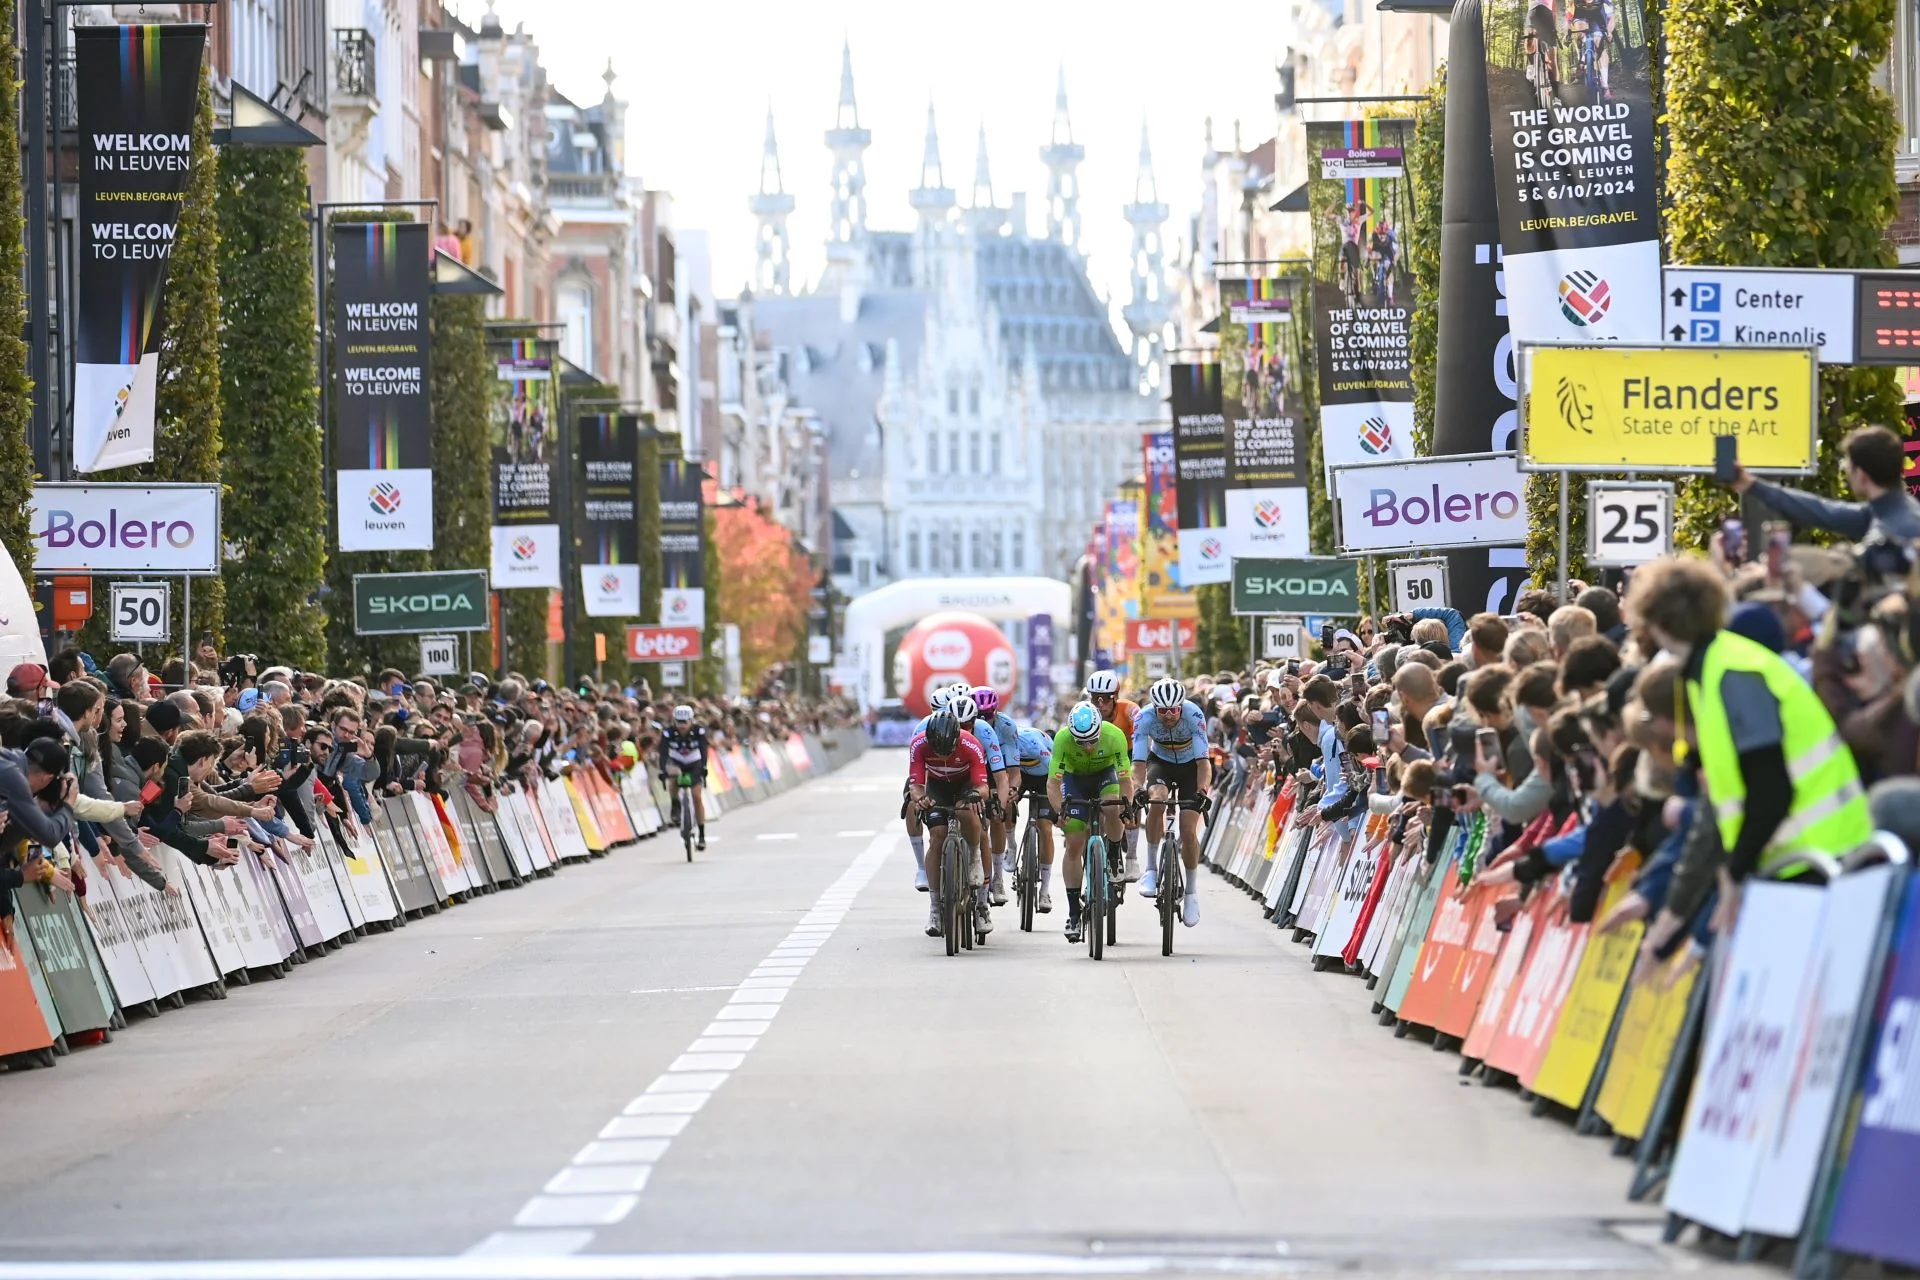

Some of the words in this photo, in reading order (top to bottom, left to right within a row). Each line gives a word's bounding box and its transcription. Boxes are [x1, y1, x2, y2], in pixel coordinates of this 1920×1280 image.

[1510, 109, 1548, 127] THE
[1554, 103, 1630, 124] WORLD
[92, 134, 190, 151] WELKOM
[1512, 129, 1542, 148] OF
[1547, 123, 1632, 146] GRAVEL
[1348, 149, 1376, 158] Bolero
[1514, 151, 1535, 170] IS
[1540, 144, 1633, 167] COMING
[95, 155, 113, 171] IN
[119, 155, 190, 171] LEUVEN
[1516, 171, 1561, 183] HALLE
[1578, 165, 1634, 179] LEUVEN
[95, 191, 184, 201] LEUVEN.BE/GRAVE
[1518, 189, 1527, 202] 5
[1532, 188, 1543, 200] &
[1548, 180, 1635, 200] 6/10/2024
[1520, 211, 1638, 232] LEUVEN.BE/GRAVEL
[92, 223, 177, 240] WELCOM
[92, 243, 117, 259] TO
[1735, 289, 1804, 309] Center
[346, 303, 418, 317] WELKOM
[1328, 309, 1354, 322] THE
[1356, 308, 1407, 321] WORLD
[347, 318, 361, 332] IN
[365, 317, 418, 331] LEUVEN
[1330, 323, 1350, 335] OF
[1352, 321, 1408, 335] GRAVEL
[347, 344, 418, 354] LEUVEN.BE/GRAVEL
[1331, 337, 1345, 350] IS
[1348, 335, 1407, 348] COMING
[1331, 350, 1361, 359] HALLE
[1370, 349, 1408, 358] LEUVEN
[1332, 361, 1339, 372] 5
[1342, 361, 1351, 371] &
[1353, 359, 1409, 370] 6/10/2024
[345, 367, 421, 381] WELCOME
[345, 382, 364, 396] TO
[367, 381, 421, 395] LEUVEN
[1623, 376, 1779, 411] Flanders
[1233, 419, 1253, 429] THE
[1254, 418, 1294, 428] WORLD
[1623, 416, 1673, 435] State
[1680, 416, 1703, 435] of
[1708, 417, 1741, 436] the
[1746, 418, 1779, 436] Art
[1233, 429, 1249, 439] OF
[1251, 428, 1294, 439] GRAVEL
[1234, 440, 1246, 450] IS
[1246, 439, 1295, 449] COMING
[1362, 483, 1519, 527] Bolero
[40, 509, 195, 548] Bolero
[365, 518, 406, 531] leuven
[1601, 504, 1660, 545] 25
[1245, 577, 1349, 596] SKODA
[1407, 578, 1433, 600] 50
[118, 597, 161, 626] 50
[369, 594, 473, 613] SKODA
[635, 631, 690, 657] lotto
[1272, 633, 1294, 647] 100
[427, 649, 449, 663] 100
[1167, 818, 1175, 830] 7
